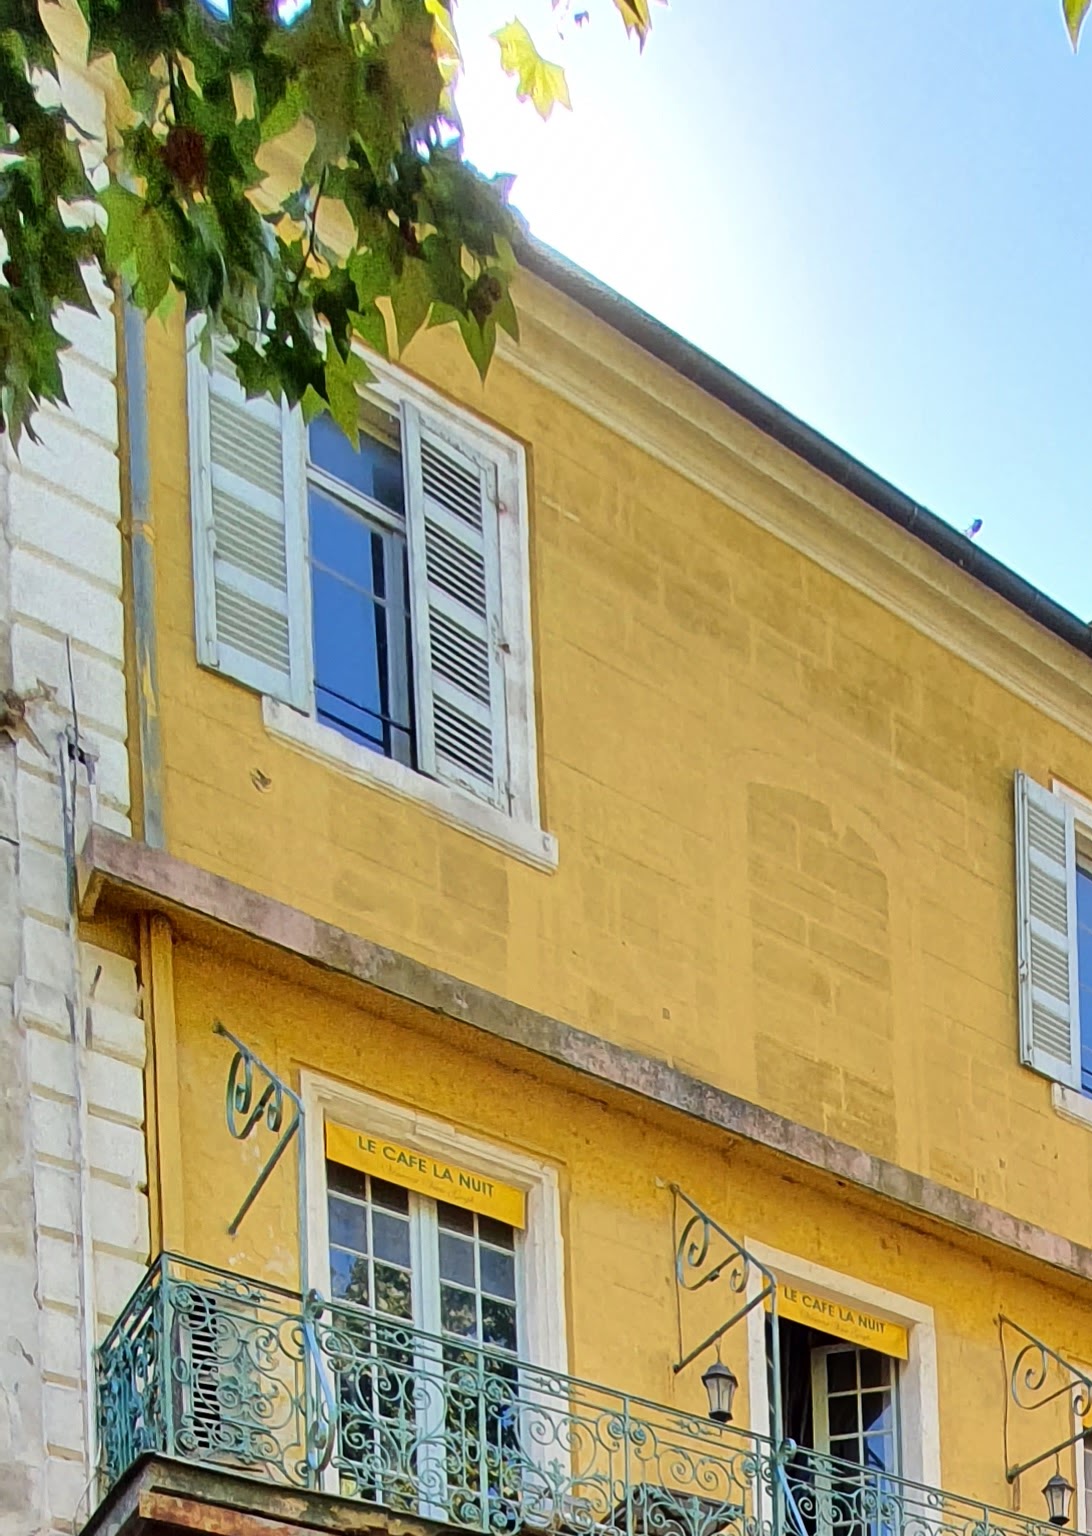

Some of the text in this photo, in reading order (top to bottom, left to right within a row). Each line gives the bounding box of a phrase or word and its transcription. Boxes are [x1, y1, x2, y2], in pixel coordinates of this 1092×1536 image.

[358, 1136, 376, 1153] LE
[383, 1146, 427, 1173] CAFE
[433, 1163, 453, 1182] LA
[459, 1173, 495, 1197] NUIT
[784, 1286, 797, 1303] LE
[802, 1295, 835, 1317] CAFE
[839, 1308, 855, 1324] LA
[858, 1315, 886, 1334] NUIT
